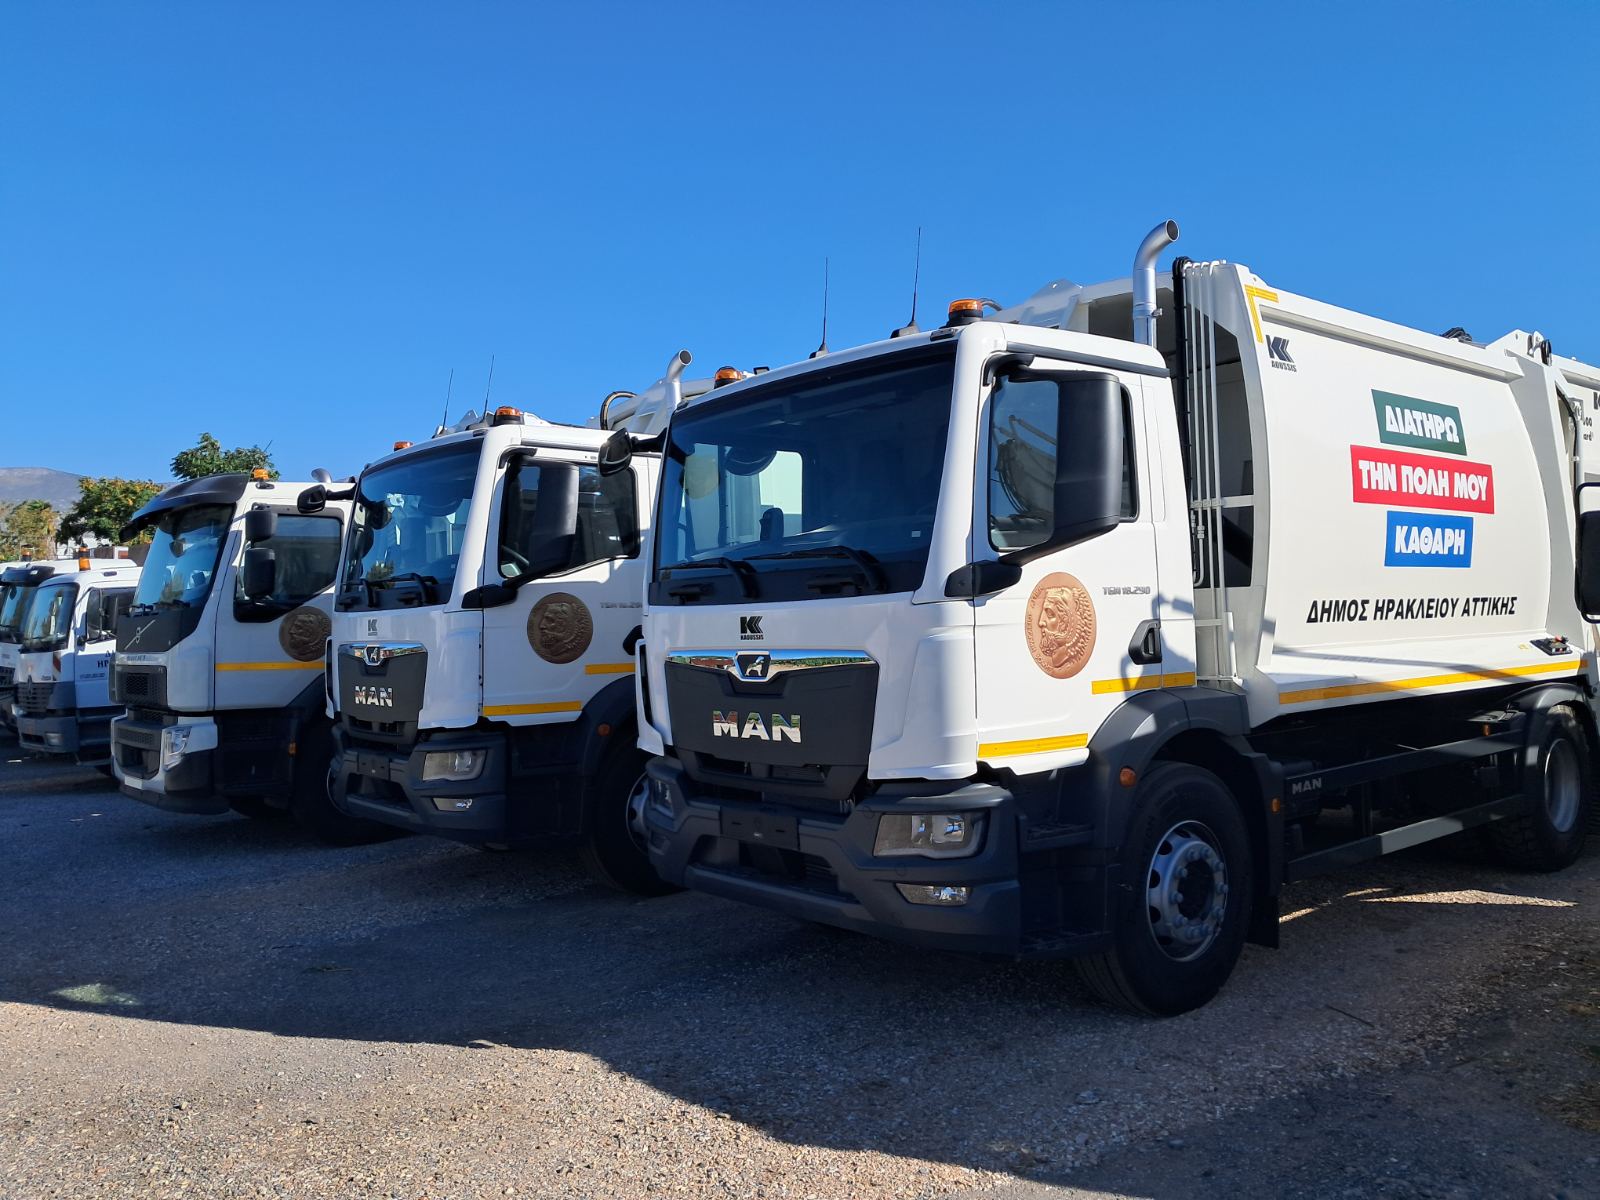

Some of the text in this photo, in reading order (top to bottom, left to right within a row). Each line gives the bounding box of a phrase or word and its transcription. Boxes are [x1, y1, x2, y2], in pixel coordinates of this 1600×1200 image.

[1385, 405, 1459, 443] ΔΙΑΤΗΡΩ
[1358, 459, 1488, 501] ΤΗΝ ΠΟΛΗ ΜΟΥ
[1395, 525, 1465, 555] ΚΑΘΑΡΗ
[1306, 597, 1518, 623] ΔΗΜΟΣ ΗΡΑΚΛΕΙΟΥ ΑΤΤΙΚΗΣ
[354, 685, 393, 708] MAN
[712, 710, 802, 743] MAN
[1292, 777, 1322, 795] MAN
